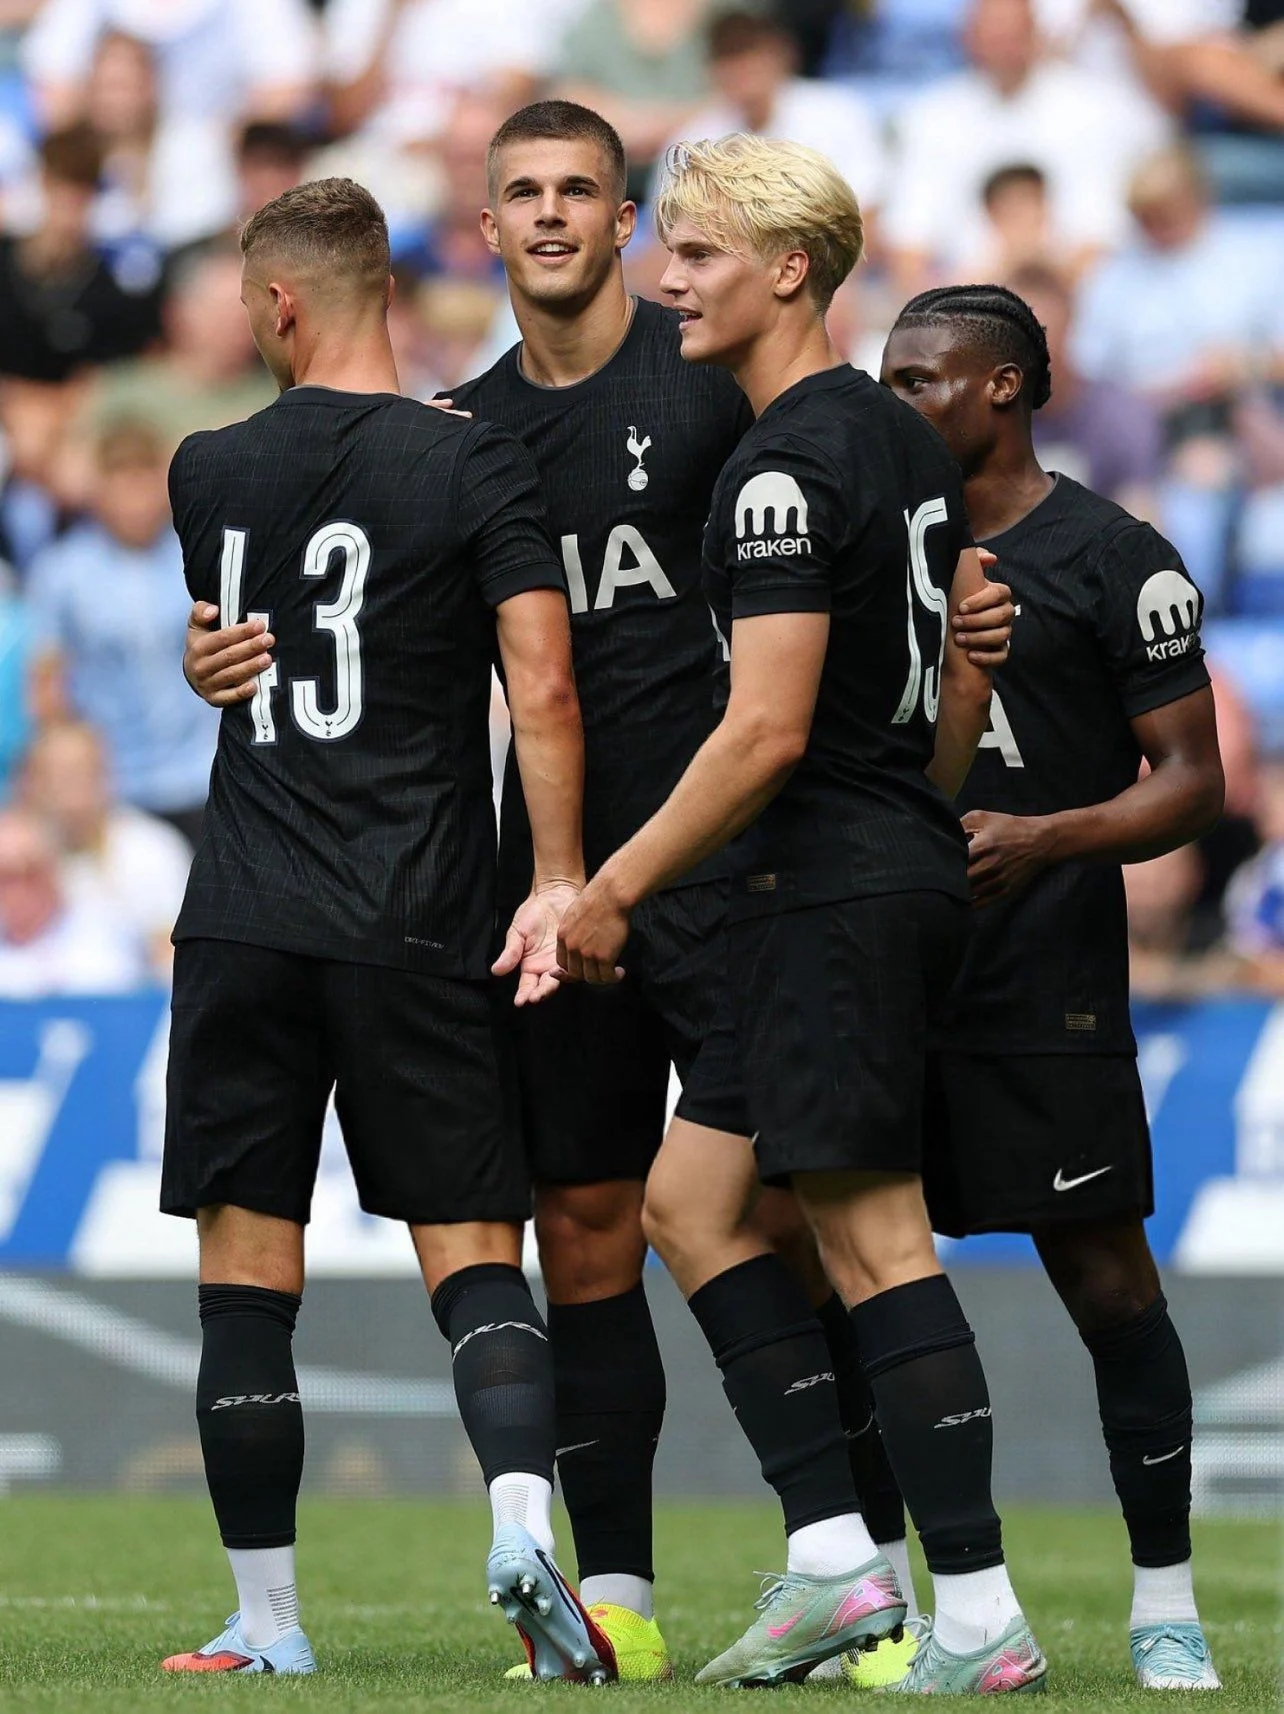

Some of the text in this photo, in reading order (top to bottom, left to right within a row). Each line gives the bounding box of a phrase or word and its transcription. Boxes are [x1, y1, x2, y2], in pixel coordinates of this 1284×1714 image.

[737, 537, 811, 561] kraken
[561, 524, 677, 614] IA
[891, 497, 948, 723] 15
[220, 520, 372, 743] 43
[1146, 632, 1196, 661] krak
[784, 1372, 835, 1395] SPU
[934, 1407, 991, 1429] SPU
